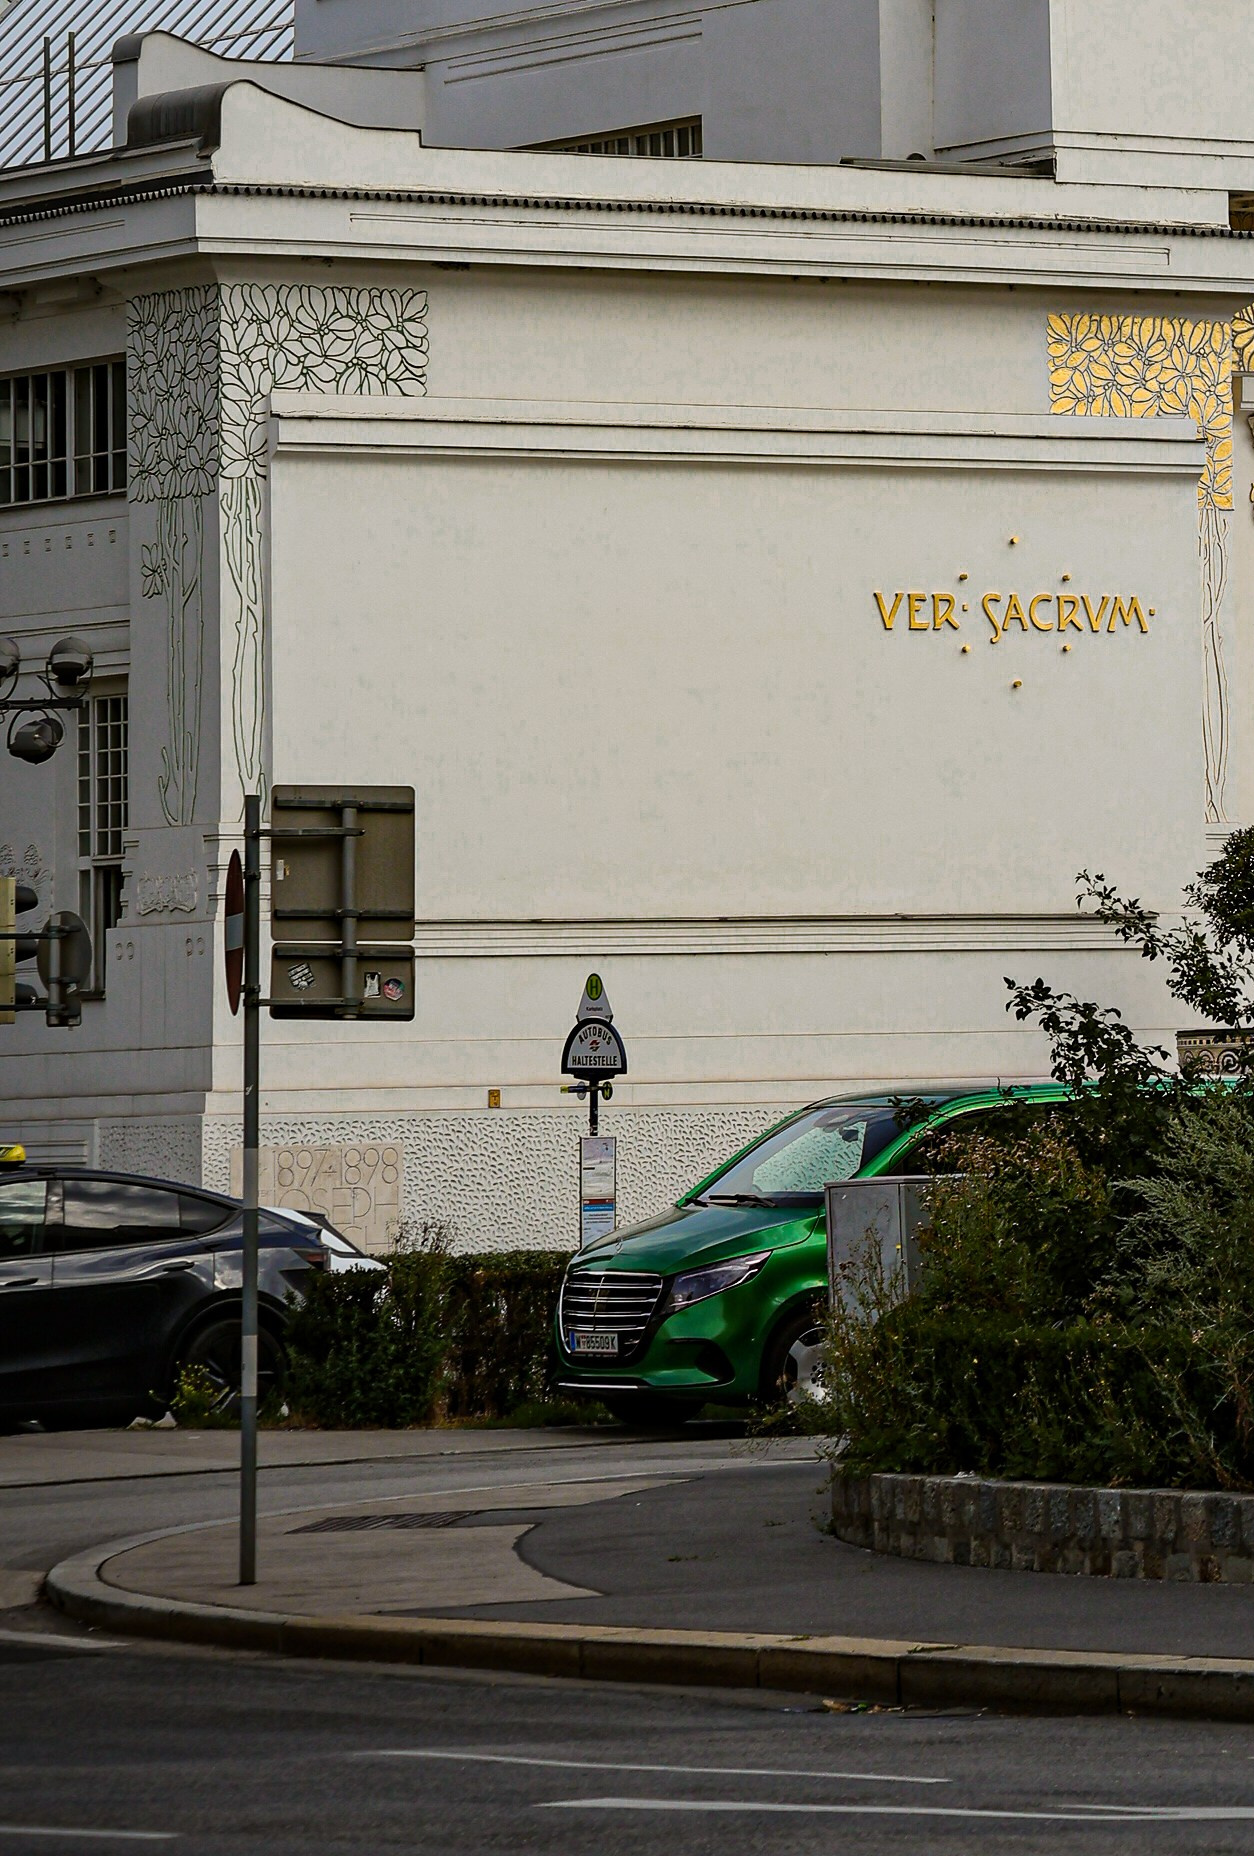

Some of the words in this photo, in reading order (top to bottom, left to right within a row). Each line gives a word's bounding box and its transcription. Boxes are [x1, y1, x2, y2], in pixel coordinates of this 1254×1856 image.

[873, 592, 960, 631] VER
[590, 979, 599, 996] H
[578, 1026, 612, 1046] AUTOBUS
[571, 1055, 618, 1067] HALTESTELLE
